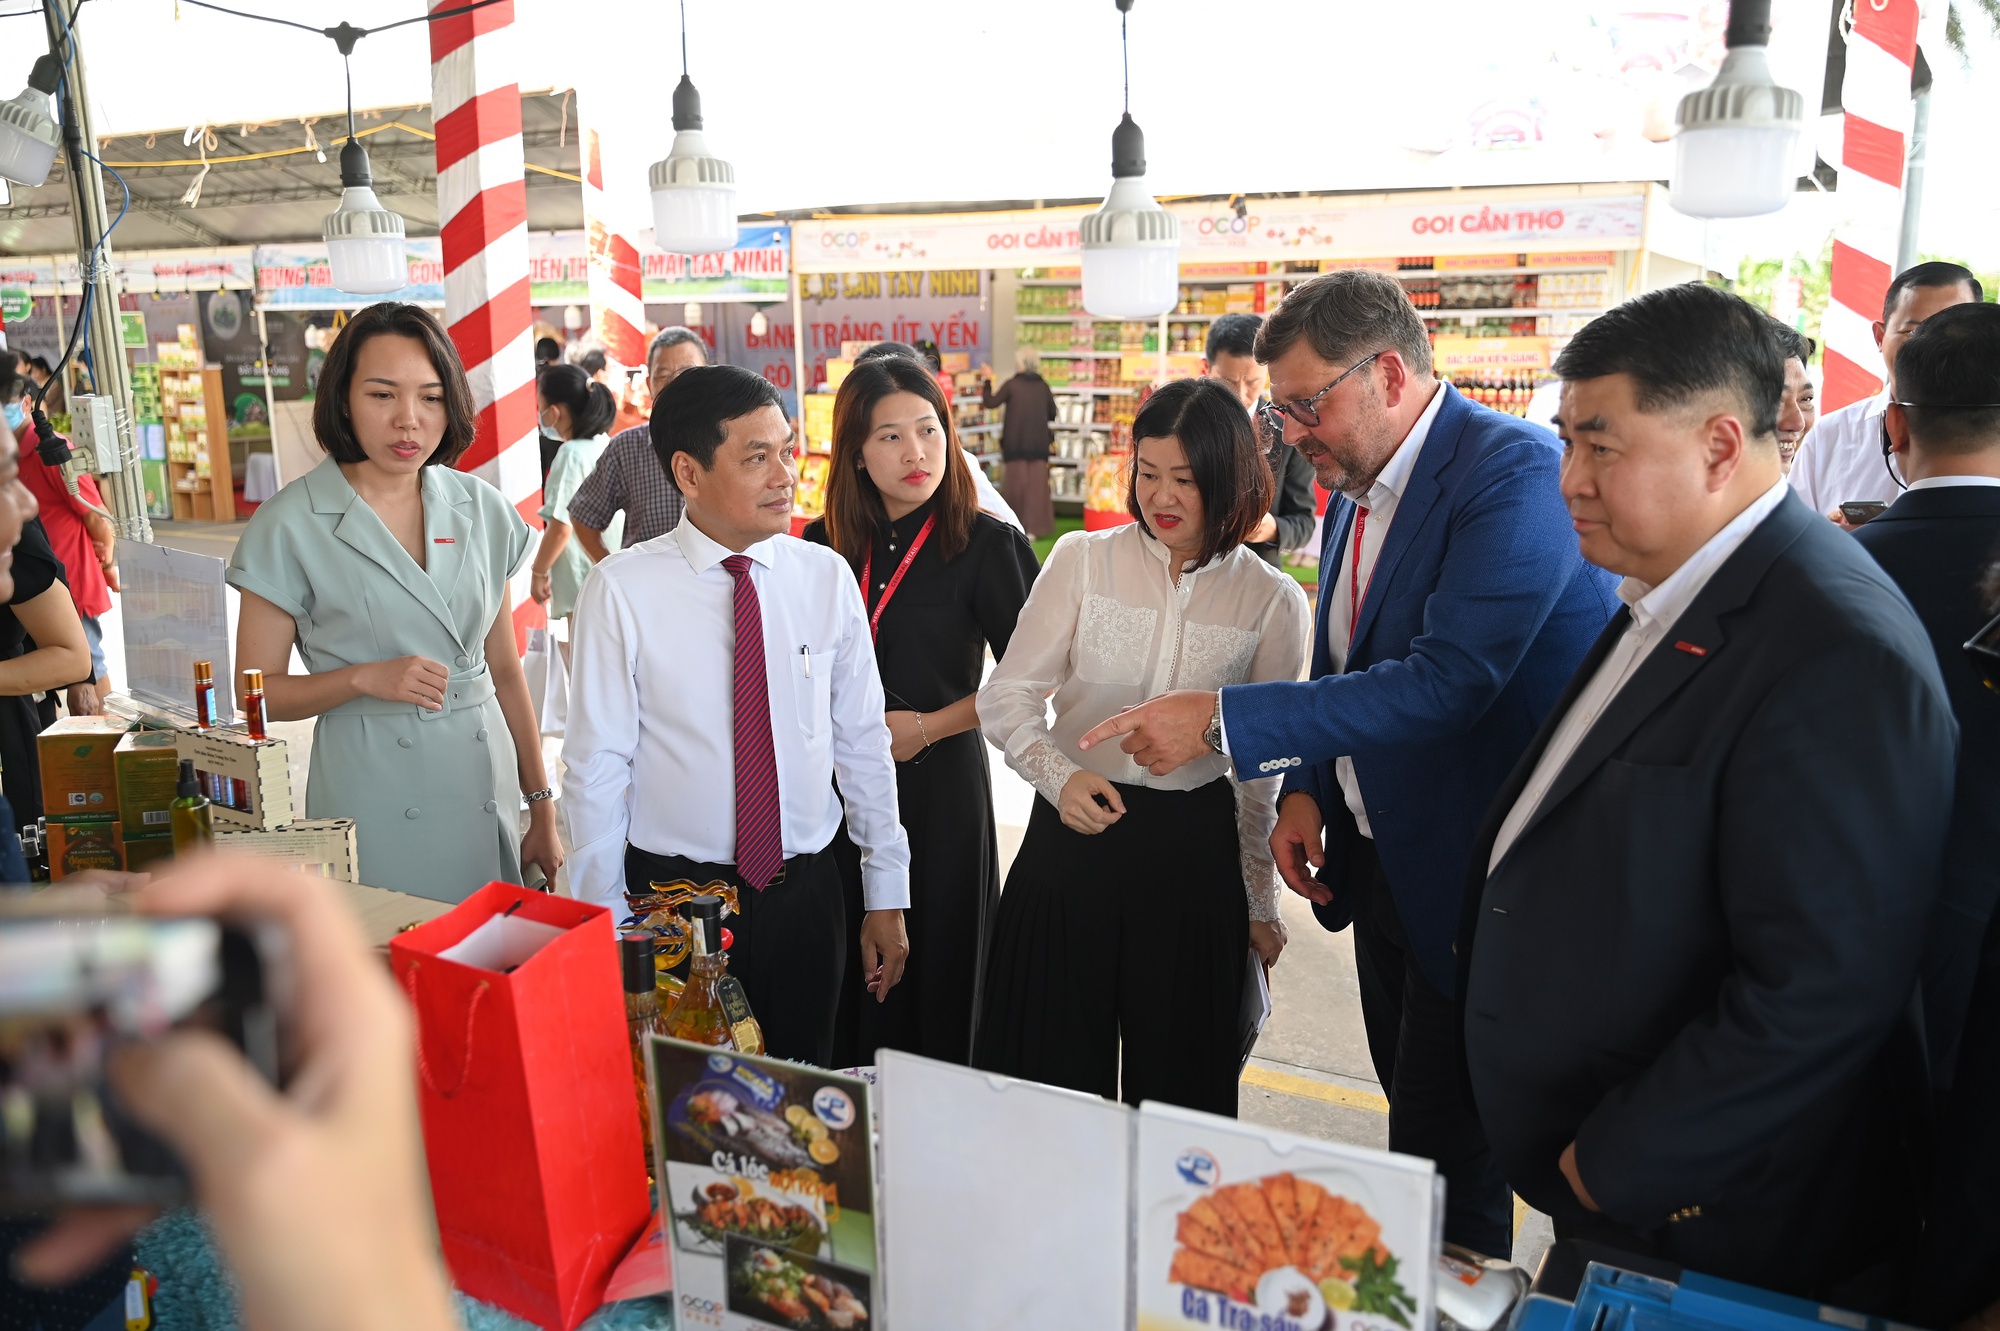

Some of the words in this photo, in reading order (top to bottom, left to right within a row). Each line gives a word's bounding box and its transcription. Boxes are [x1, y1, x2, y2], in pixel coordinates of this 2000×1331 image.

[1199, 216, 1262, 235] OCOP
[1412, 215, 1453, 234] GO!
[1515, 209, 1565, 231] THƠ
[821, 231, 870, 248] OCOP
[987, 233, 1019, 250] GO!
[259, 267, 305, 288] TRUNG
[410, 259, 443, 285] CÔN
[733, 249, 782, 273] NINH
[929, 270, 979, 295] NINH
[811, 315, 883, 348] TRÁNG
[764, 357, 792, 388] GÒ
[904, 546, 919, 565] RETAIL
[711, 1150, 736, 1174] Cá
[739, 1155, 769, 1180] lóc
[1215, 1296, 1252, 1331] Tra
